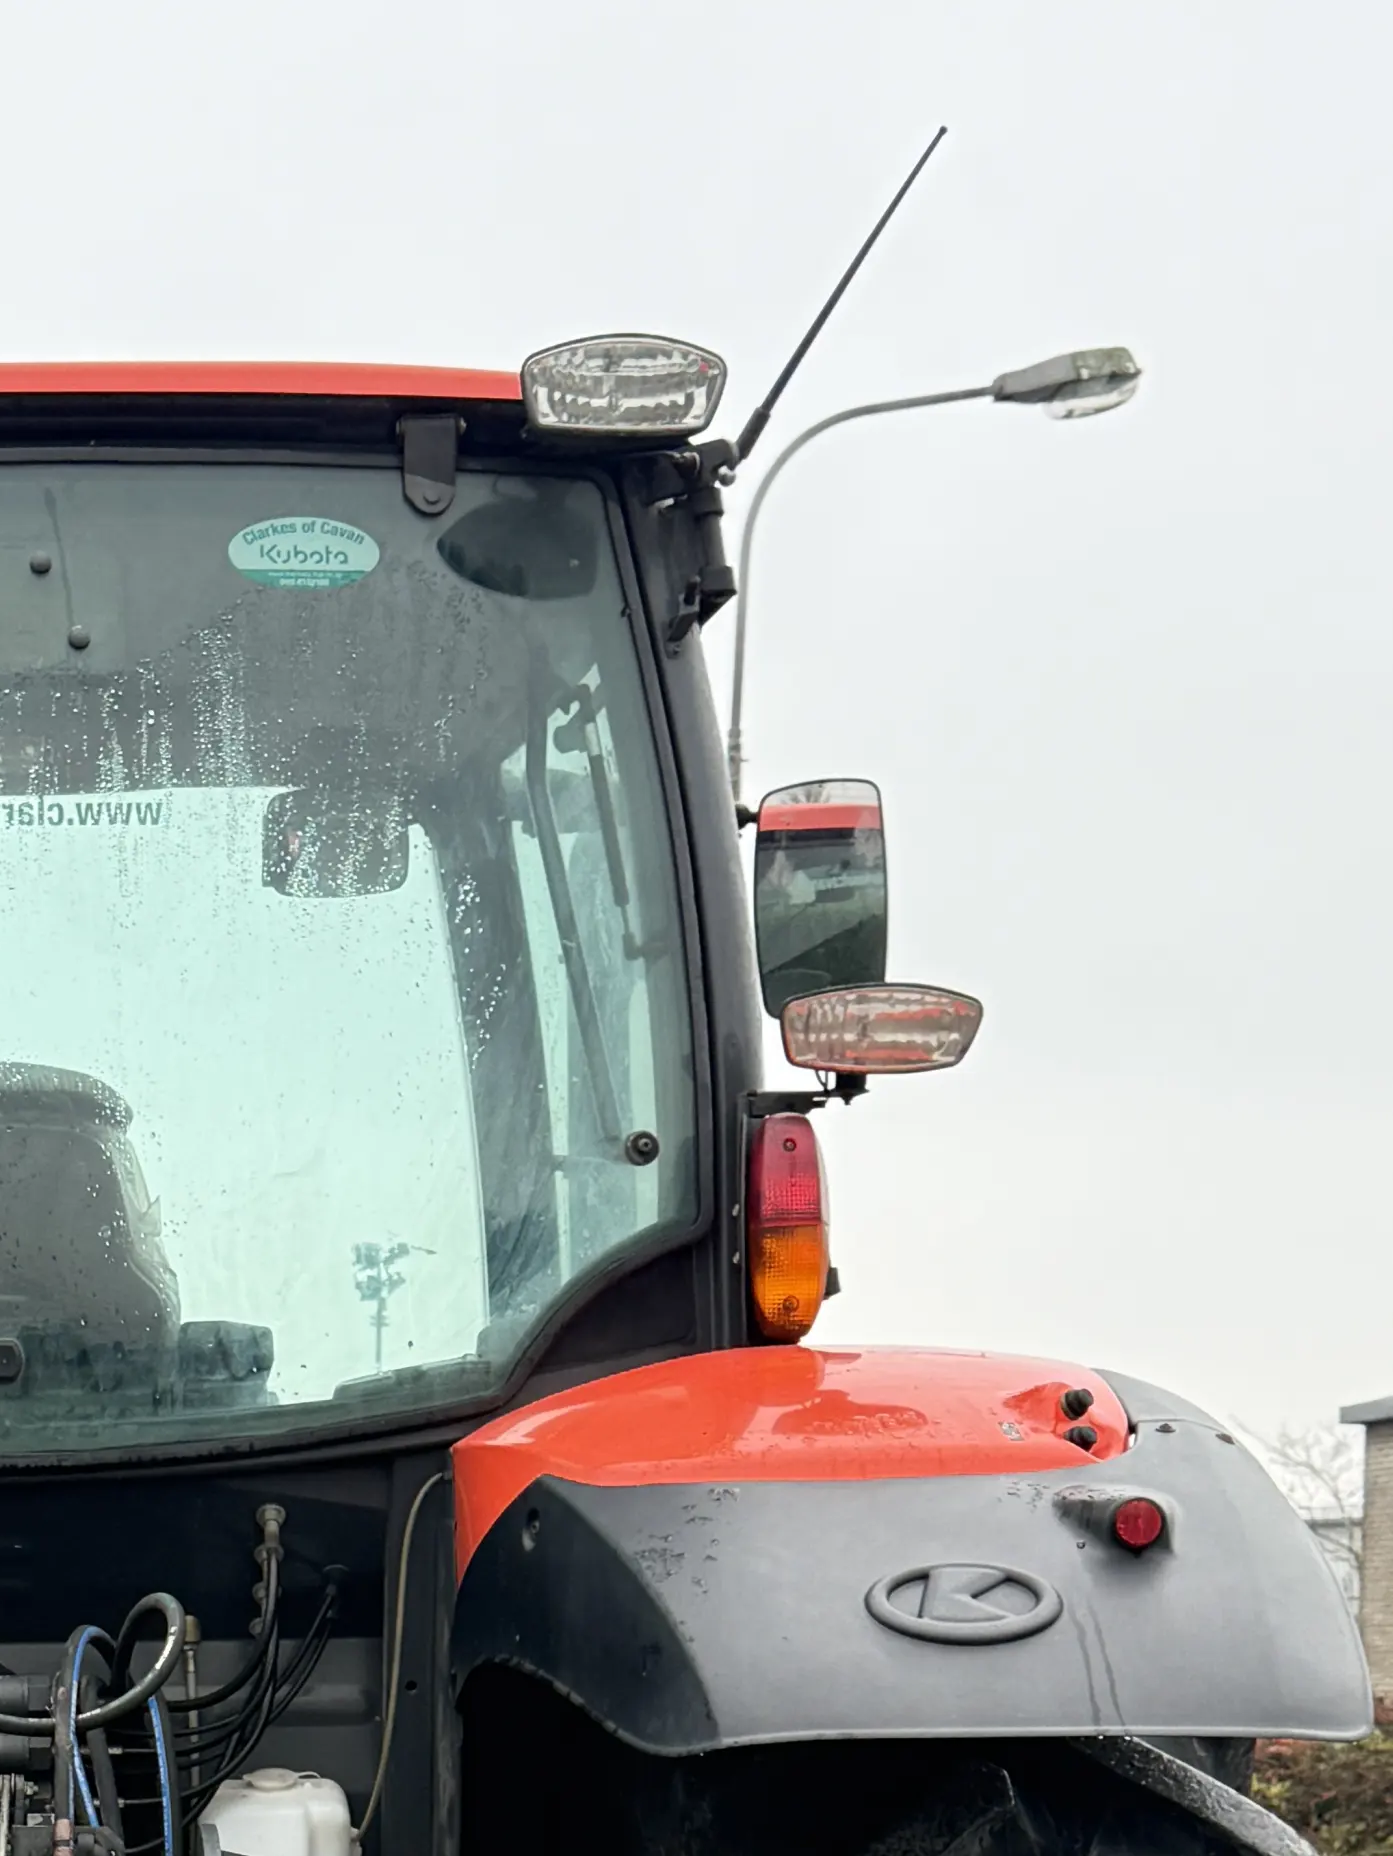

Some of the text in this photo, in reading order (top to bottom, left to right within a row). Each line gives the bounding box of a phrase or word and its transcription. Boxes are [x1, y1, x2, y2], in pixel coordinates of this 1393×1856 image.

[241, 519, 366, 545] Clarkes of Cavan
[259, 543, 349, 565] Kubota
